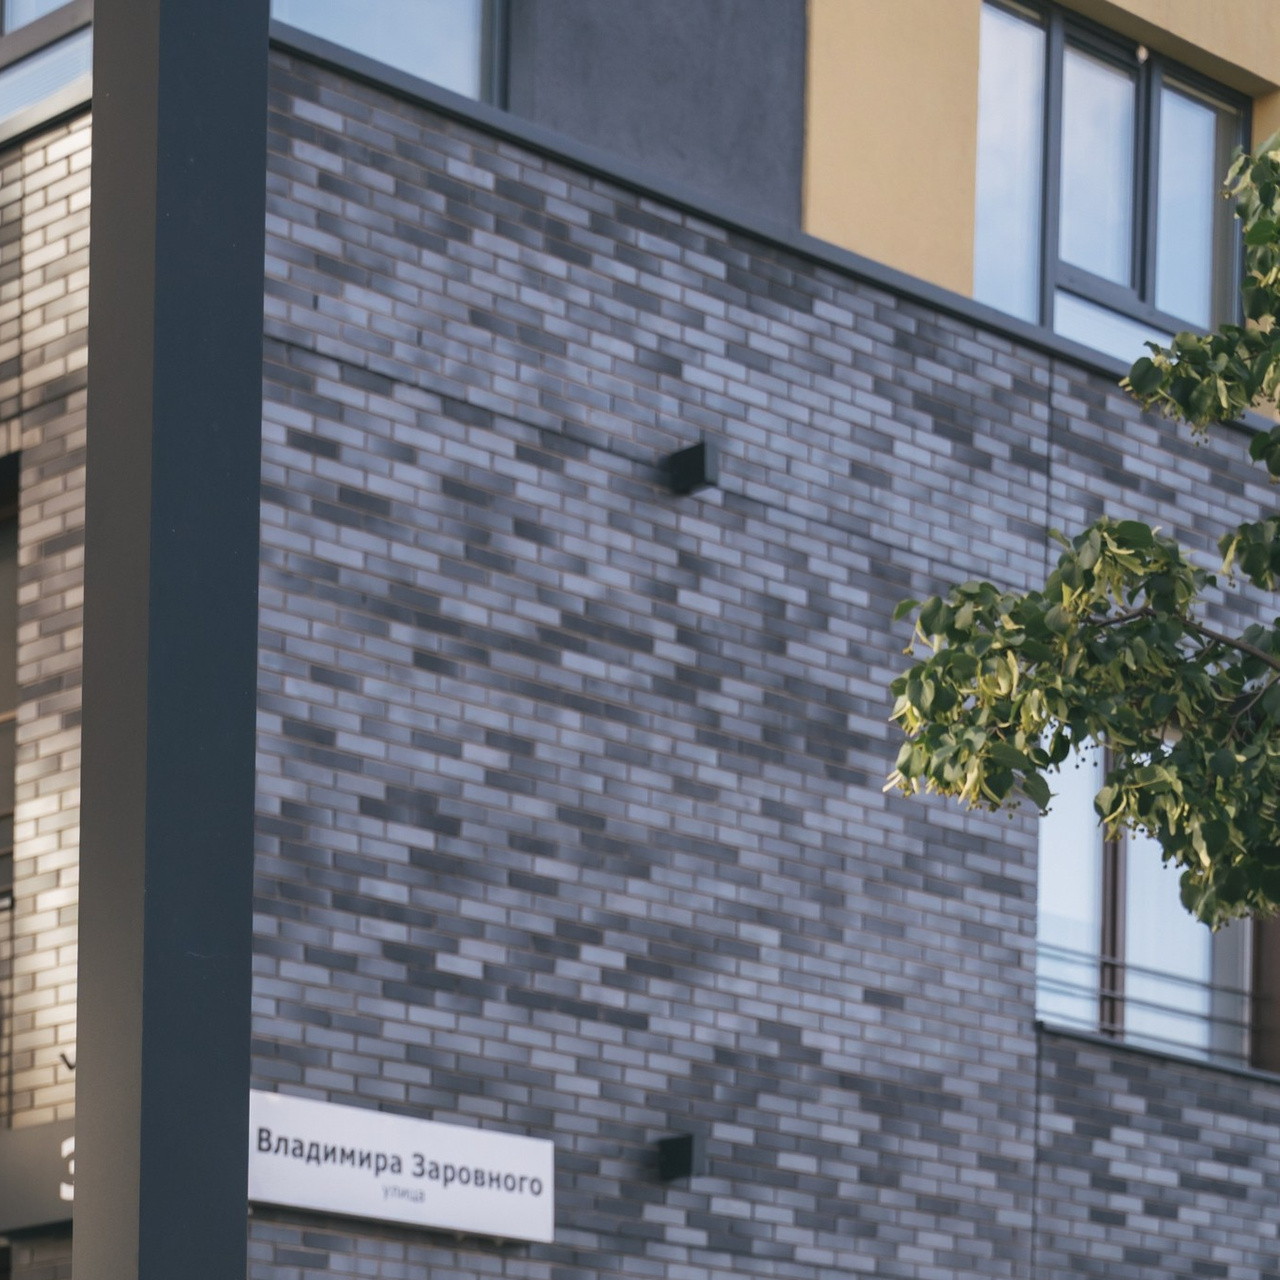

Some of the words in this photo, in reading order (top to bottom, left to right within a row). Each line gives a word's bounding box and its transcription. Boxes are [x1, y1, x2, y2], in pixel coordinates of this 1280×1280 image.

[256, 1127, 403, 1177] Владимира
[411, 1152, 544, 1197] Заровного
[382, 1183, 426, 1203] улица
